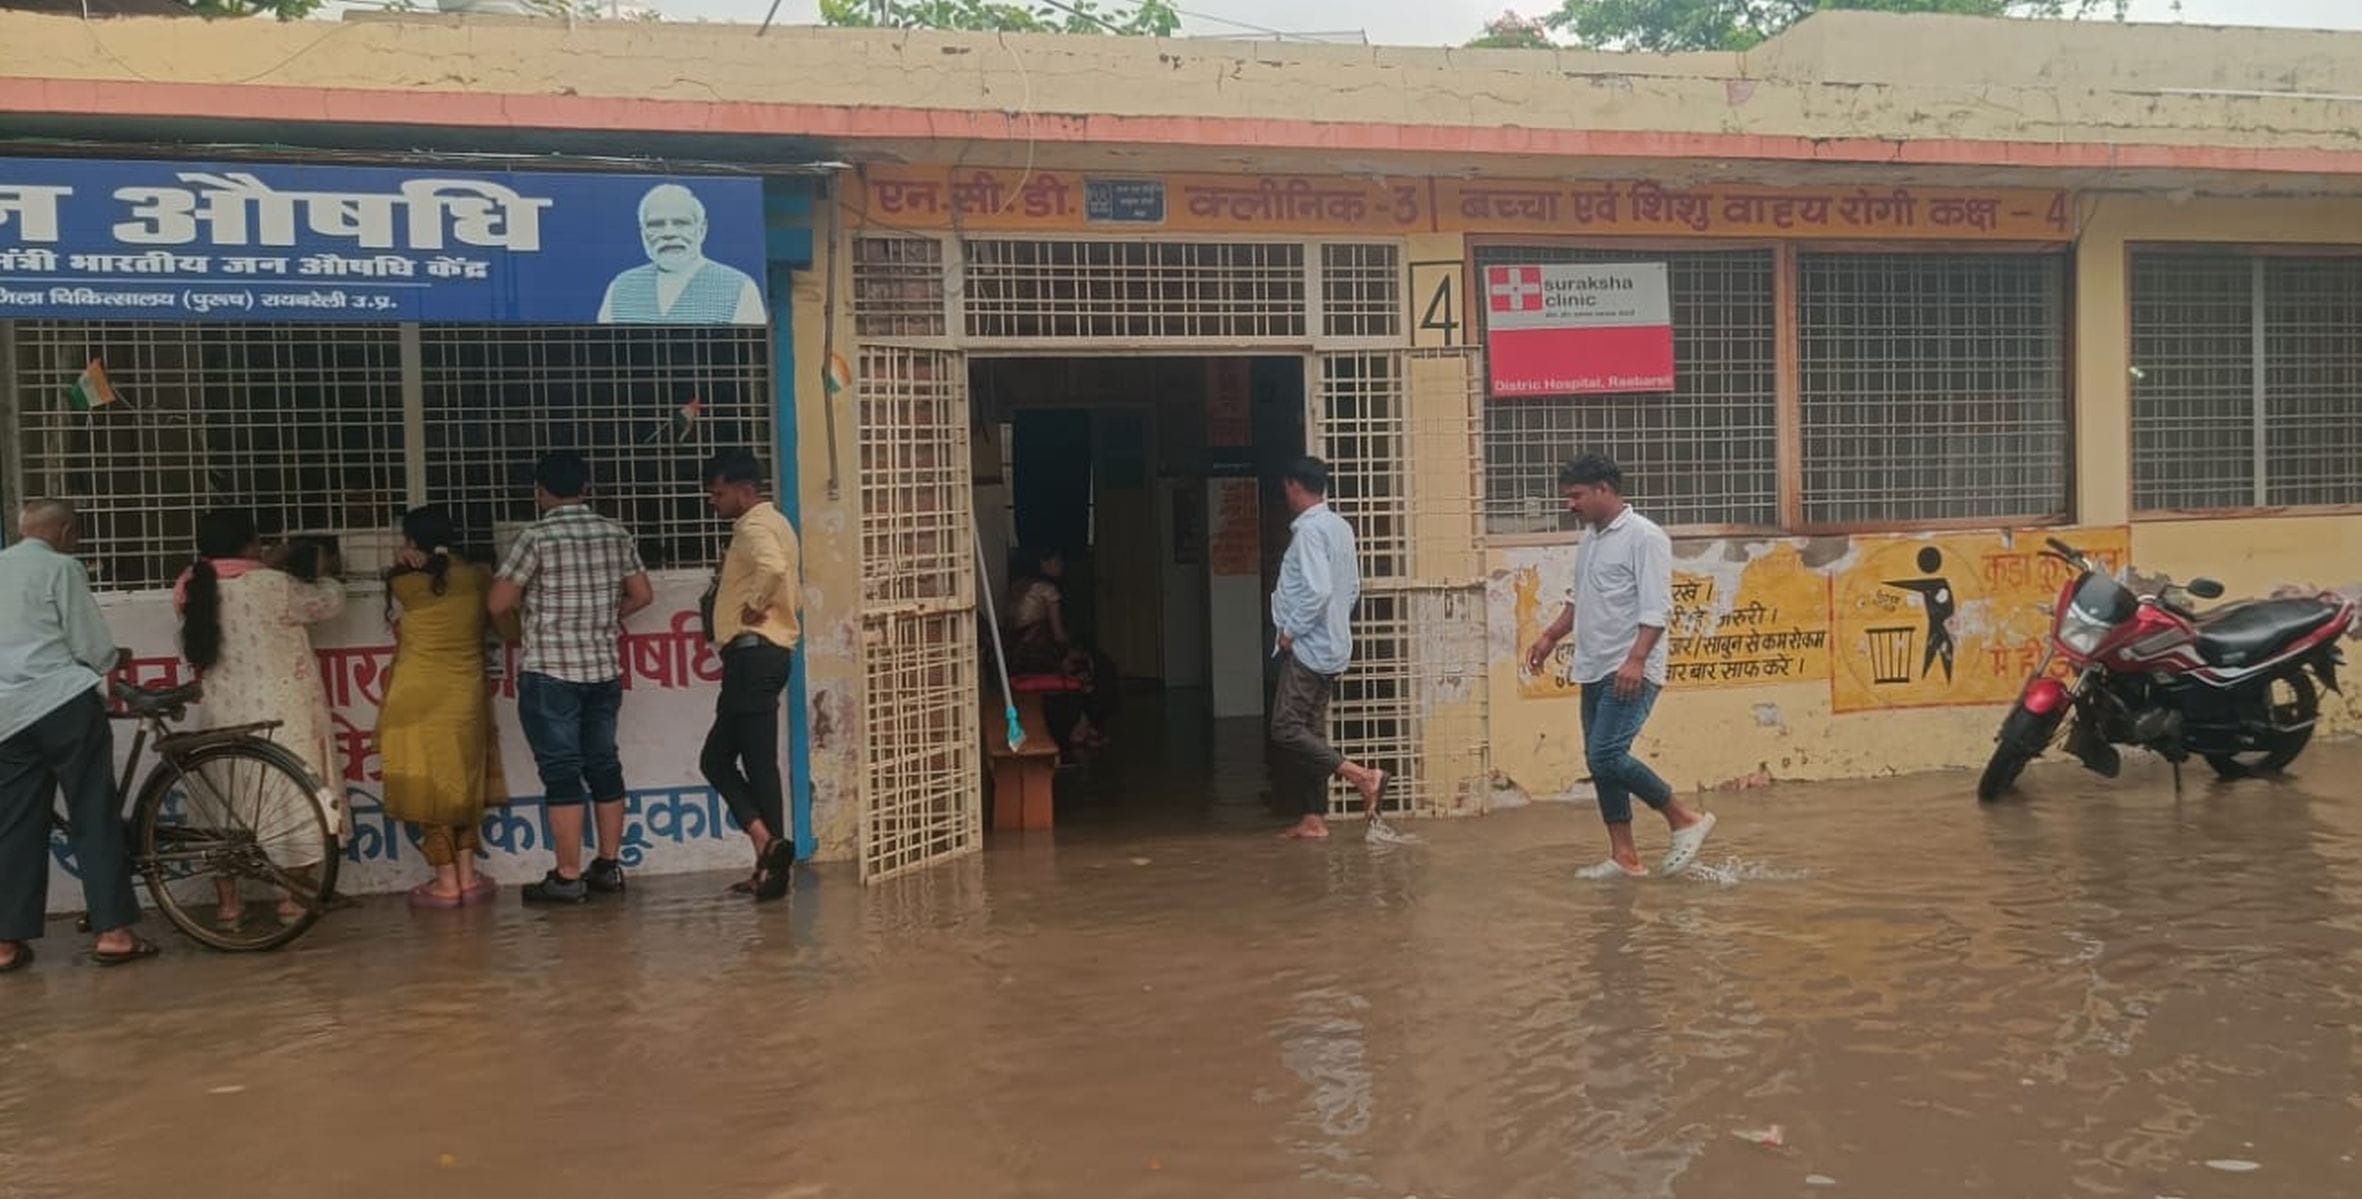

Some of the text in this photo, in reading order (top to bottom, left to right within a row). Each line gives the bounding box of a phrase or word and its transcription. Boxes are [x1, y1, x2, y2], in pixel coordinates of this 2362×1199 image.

[112, 172, 553, 252] औषधि
[1459, 189, 1562, 221] बच्चा
[1572, 182, 1620, 223] एवं
[1627, 180, 1714, 232] शिशु
[1930, 198, 2001, 231] कक्ष
[69, 251, 210, 273] भारतीय
[221, 257, 290, 275] जन
[299, 254, 417, 277] औषधि
[1544, 275, 1633, 291] suraksha
[50, 287, 174, 306] चिकित्सालय
[1420, 272, 1460, 346] 4
[1545, 293, 1597, 308] clinic
